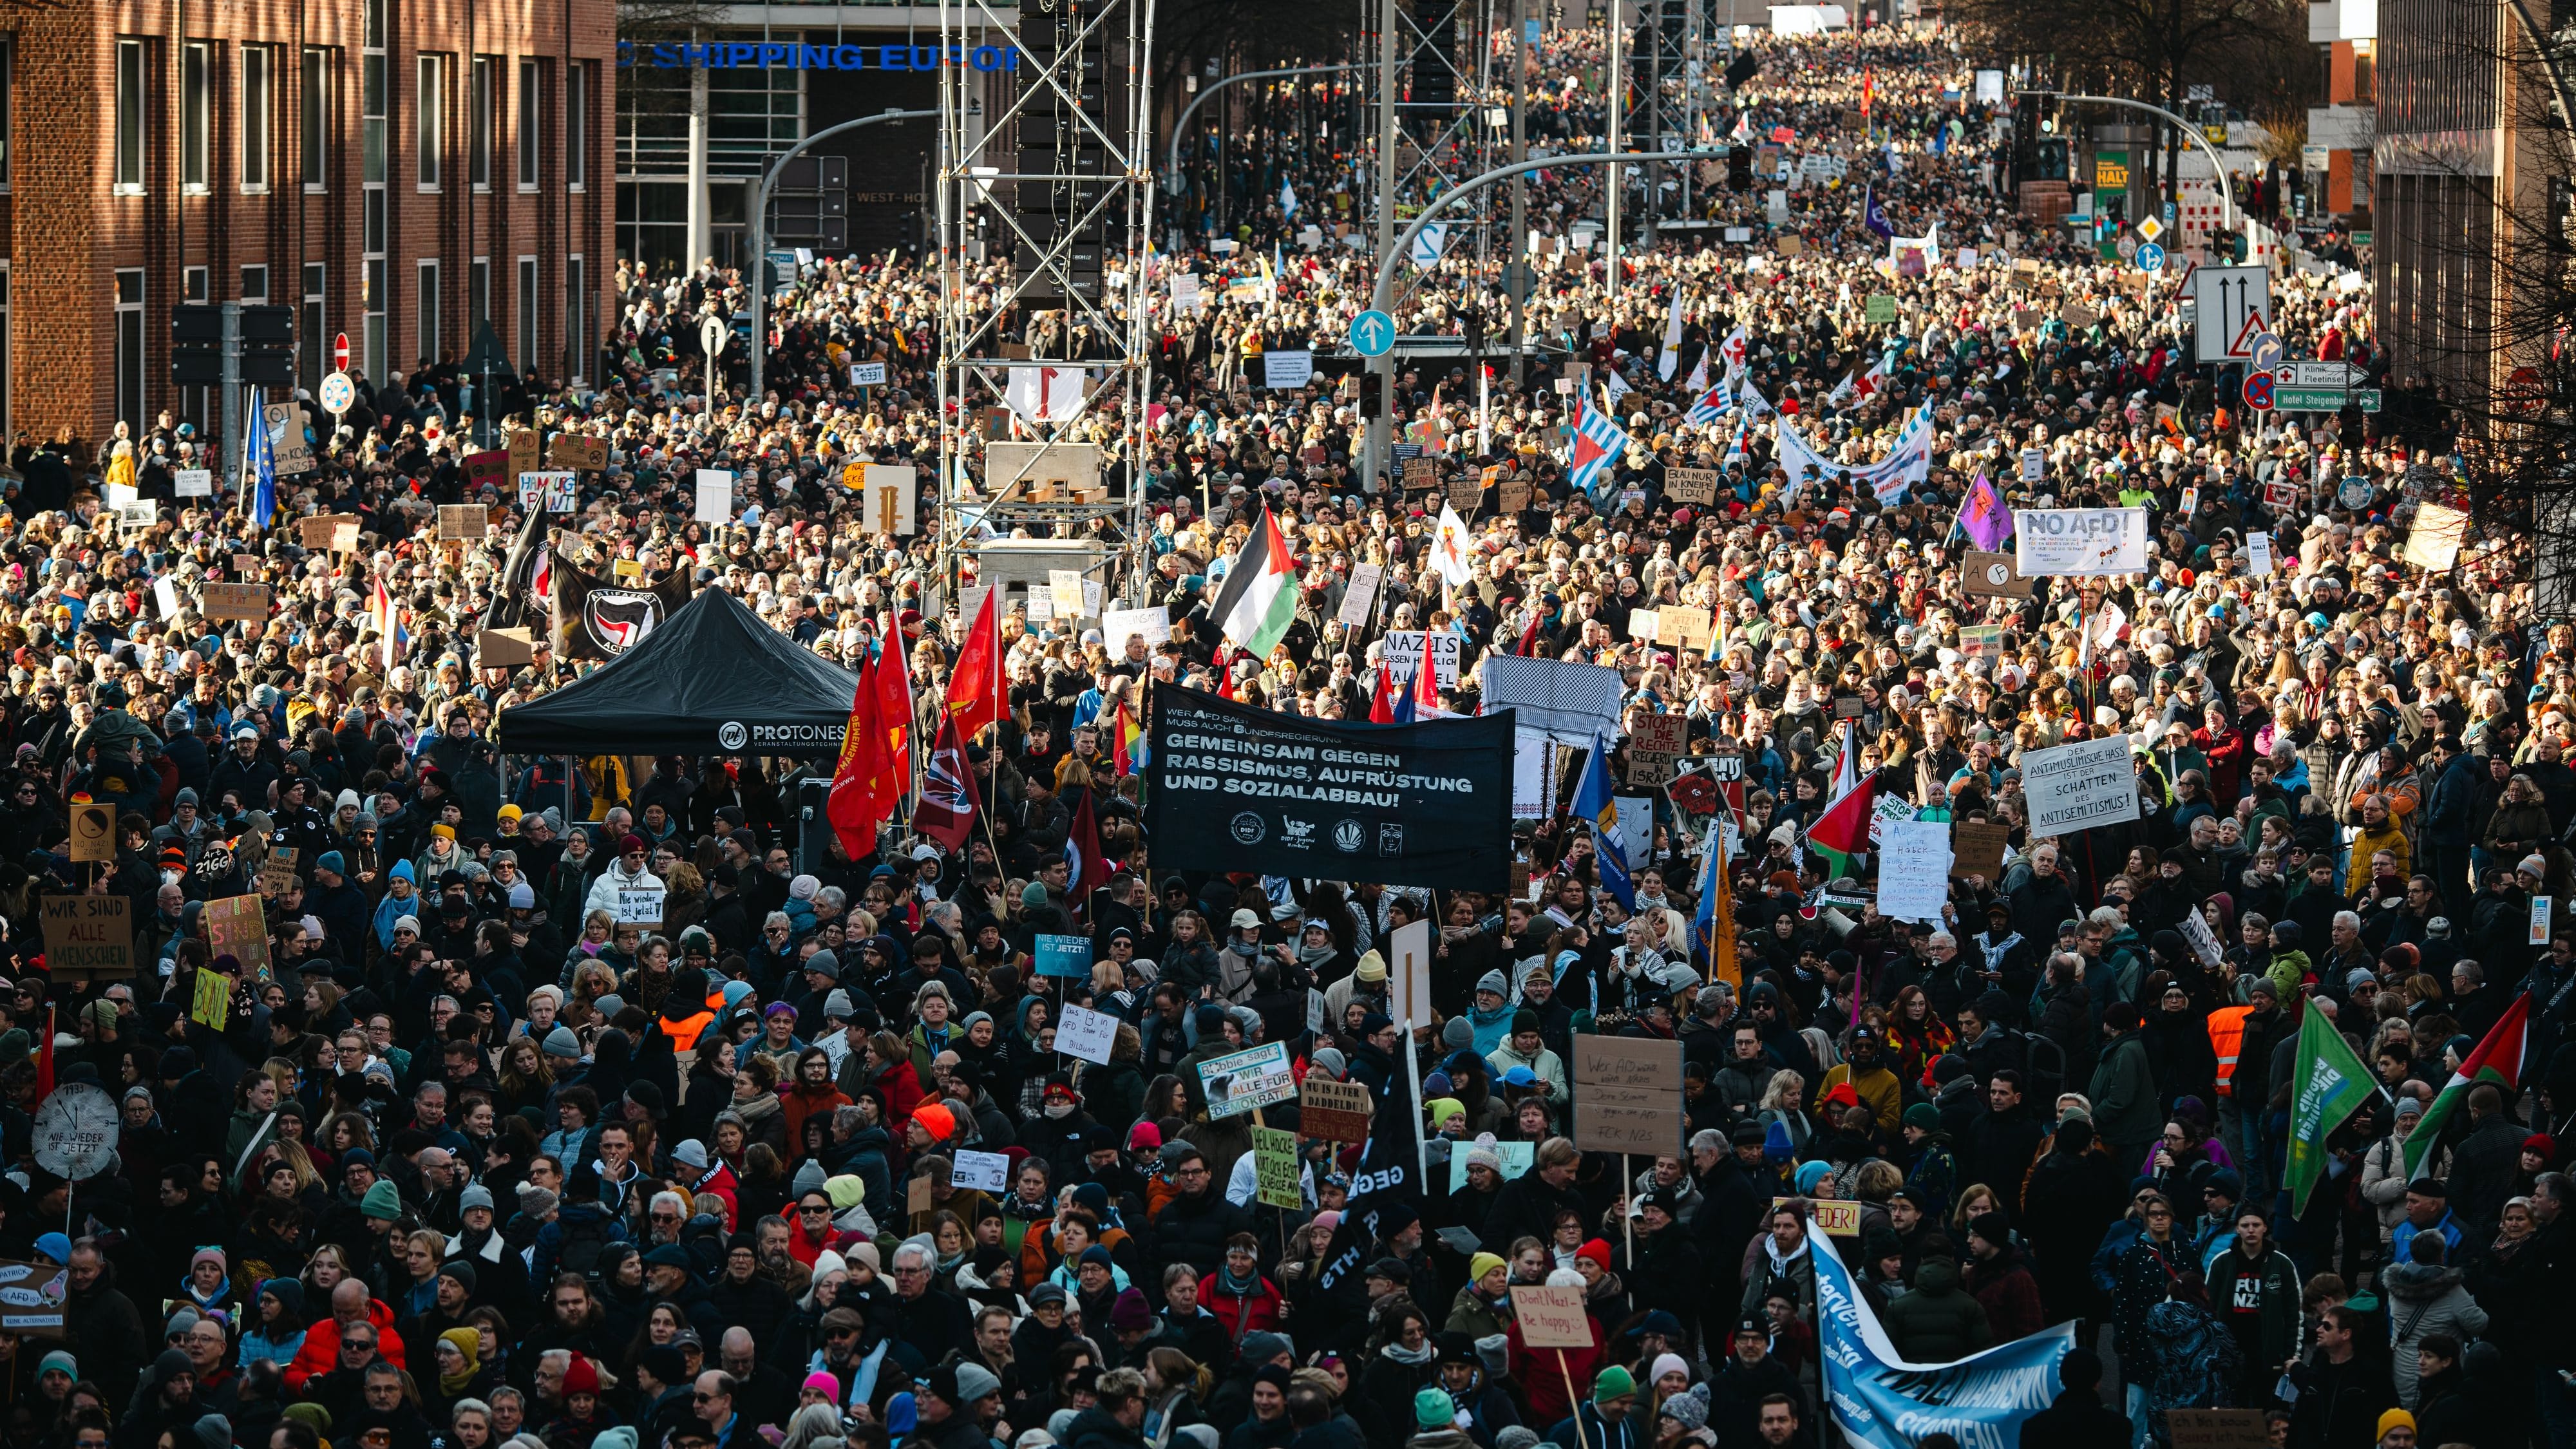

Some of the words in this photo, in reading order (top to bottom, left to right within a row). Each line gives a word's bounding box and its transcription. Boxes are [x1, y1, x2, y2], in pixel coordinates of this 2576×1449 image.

[652, 43, 863, 70] SHIPPING
[2097, 171, 2128, 184] HALT
[2305, 365, 2327, 374] Klinik
[2305, 374, 2344, 383] Fleetinsel
[2283, 394, 2302, 404] Hotel
[1405, 460, 1416, 468] DIE
[1418, 459, 1430, 468] AFD
[1405, 478, 1419, 486] MICH
[1669, 469, 1690, 480] BLAU
[1692, 471, 1713, 482] NUR
[522, 475, 576, 494] HAMBURG
[1681, 480, 1713, 491] KNEIPE
[1678, 489, 1705, 500] TOLL!
[2027, 513, 2065, 535] NO
[1968, 565, 1980, 579] A
[1995, 565, 2005, 582] F
[591, 590, 658, 604] ANTIFASCIST
[1166, 708, 1192, 718] WER
[1166, 717, 1198, 728] MUSS
[1201, 723, 1231, 733] AUCH
[1233, 724, 1341, 743] BUNDESREGIERUNG
[1636, 714, 1687, 731] STOPPT
[753, 725, 846, 741] PROTONES
[1654, 729, 1674, 741] DIE
[1166, 734, 1315, 761] GEMEINSAM
[1321, 749, 1400, 768] GEGEN
[1635, 737, 1679, 752] RECHTE
[2067, 746, 2085, 757] DER
[2030, 751, 2105, 776] ANTIMUSLIMISCHE
[2104, 745, 2125, 759] HASS
[1654, 764, 1663, 773] IN
[2063, 770, 2079, 781] IST
[2079, 766, 2094, 777] DER
[1318, 766, 1473, 793] AUFRÜSTUNG
[2056, 774, 2117, 796] SCHATTEN
[1165, 774, 1218, 791] UND
[1223, 778, 1399, 808] SOZIALABBAU!
[2076, 794, 2090, 803] DES
[1886, 798, 1912, 816] STOP
[74, 839, 85, 849] NO
[204, 849, 222, 859] Art
[196, 855, 229, 875] 21GG
[1607, 858, 1625, 882] Hamburg
[270, 881, 284, 892] OMA
[619, 892, 631, 905] Nie
[634, 893, 656, 904] wieder
[46, 900, 78, 919] WIR
[87, 899, 122, 916] SIND
[209, 895, 254, 920] WIR
[621, 905, 631, 918] ist
[68, 923, 106, 942] ALLE
[211, 920, 262, 945] SIND
[1037, 934, 1054, 943] NIE
[1054, 935, 1090, 945] WIEDER
[53, 945, 127, 967] MENSCHEN
[1057, 945, 1085, 954] JETZT!
[194, 972, 228, 1025] BUNT
[1066, 1006, 1079, 1017] Das
[1084, 1010, 1095, 1027] B
[1062, 1021, 1076, 1030] AFD
[1068, 1039, 1096, 1054] BILDUNG
[1587, 1054, 1608, 1073] Wer
[1239, 1066, 1263, 1081] WIR
[62, 1083, 84, 1094] 1933
[1232, 1080, 1262, 1095] ALLE
[1266, 1074, 1291, 1088] FÜR
[1305, 1081, 1319, 1092] NU
[1321, 1083, 1331, 1094] IS
[1213, 1089, 1294, 1116] DEMOKRATIE
[47, 1132, 66, 1143] NIE
[69, 1131, 105, 1145] WIEDER
[1303, 1121, 1335, 1135] BLEIBEN
[1340, 1126, 1363, 1140] HIER!
[1598, 1126, 1621, 1139] FCK
[47, 1141, 60, 1152] IST
[62, 1142, 99, 1156] JETZT
[1253, 1128, 1271, 1151] HEIL
[1271, 1132, 1293, 1155] HÖCKE
[1287, 1181, 1299, 1193] AN
[10, 1290, 28, 1302] AFD
[1517, 1290, 1544, 1305] Don't
[1545, 1289, 1569, 1305] Nazi
[1523, 1313, 1536, 1325] Be
[1540, 1312, 1572, 1333] happy
